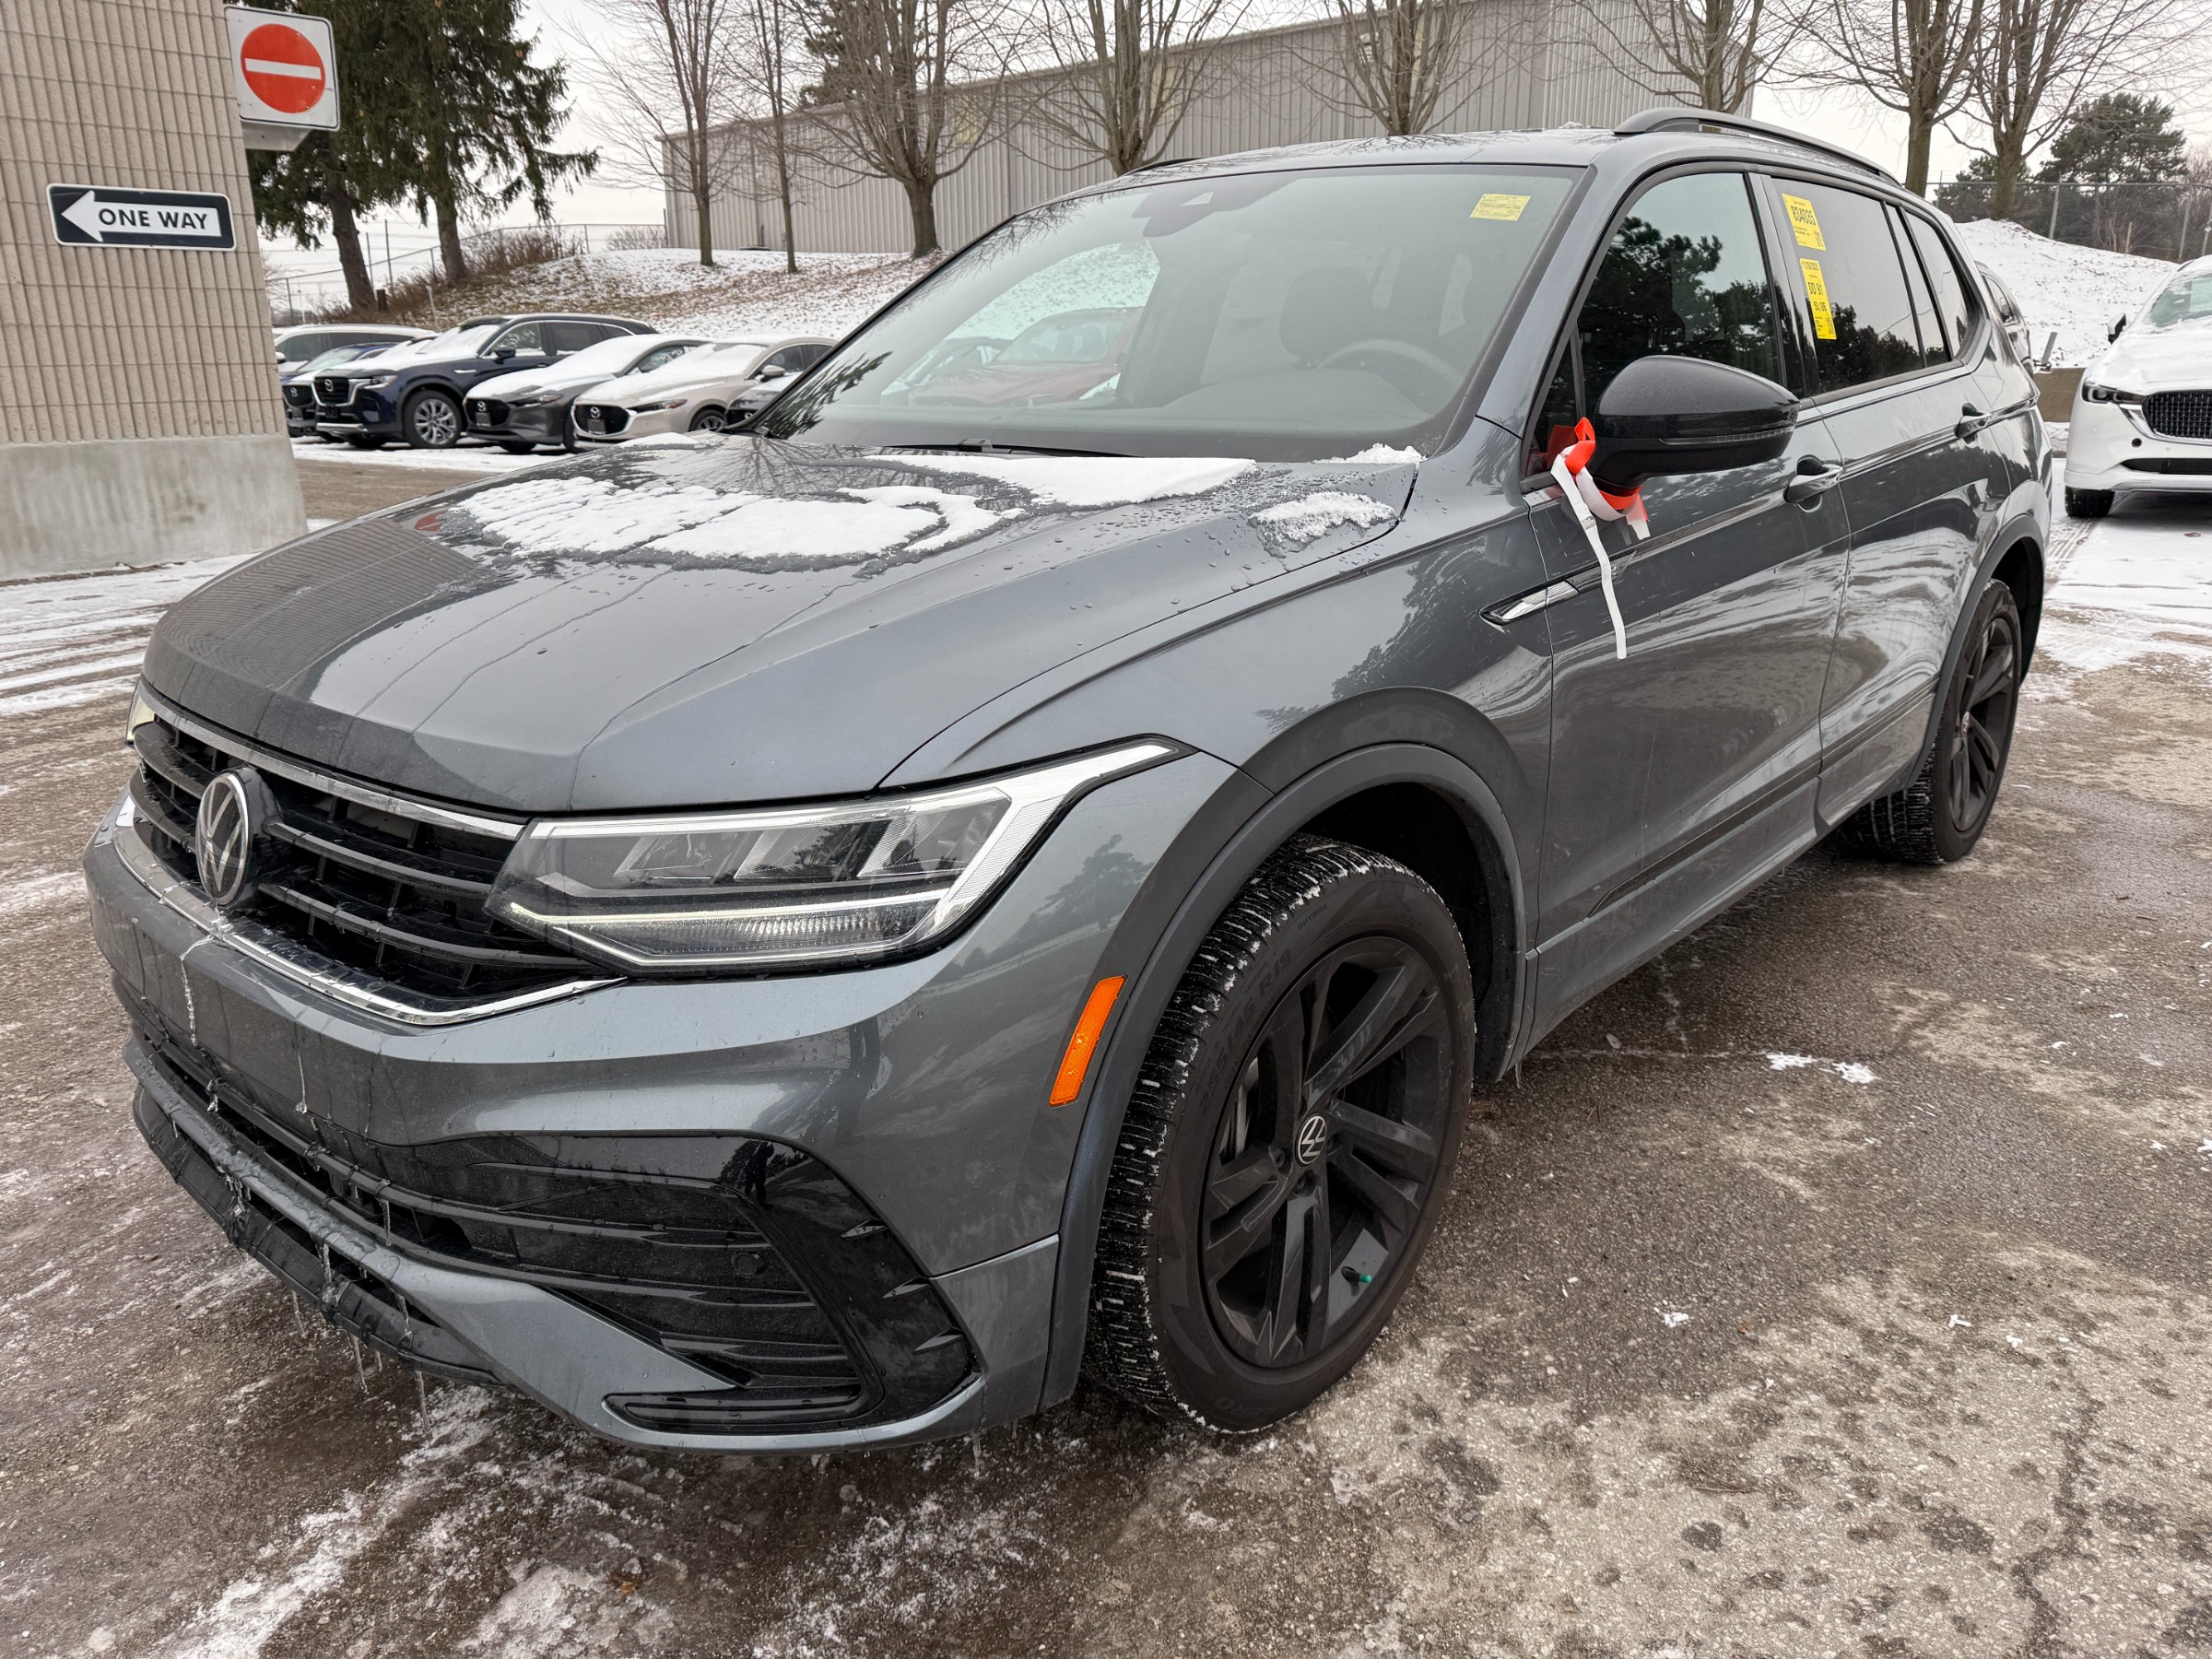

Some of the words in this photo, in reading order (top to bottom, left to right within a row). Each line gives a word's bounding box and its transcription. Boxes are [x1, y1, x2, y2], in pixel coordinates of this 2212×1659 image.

[98, 208, 150, 227] ONE
[157, 210, 207, 229] WAY
[1298, 902, 1329, 931] OUTSIDE
[1258, 948, 1291, 998] R19
